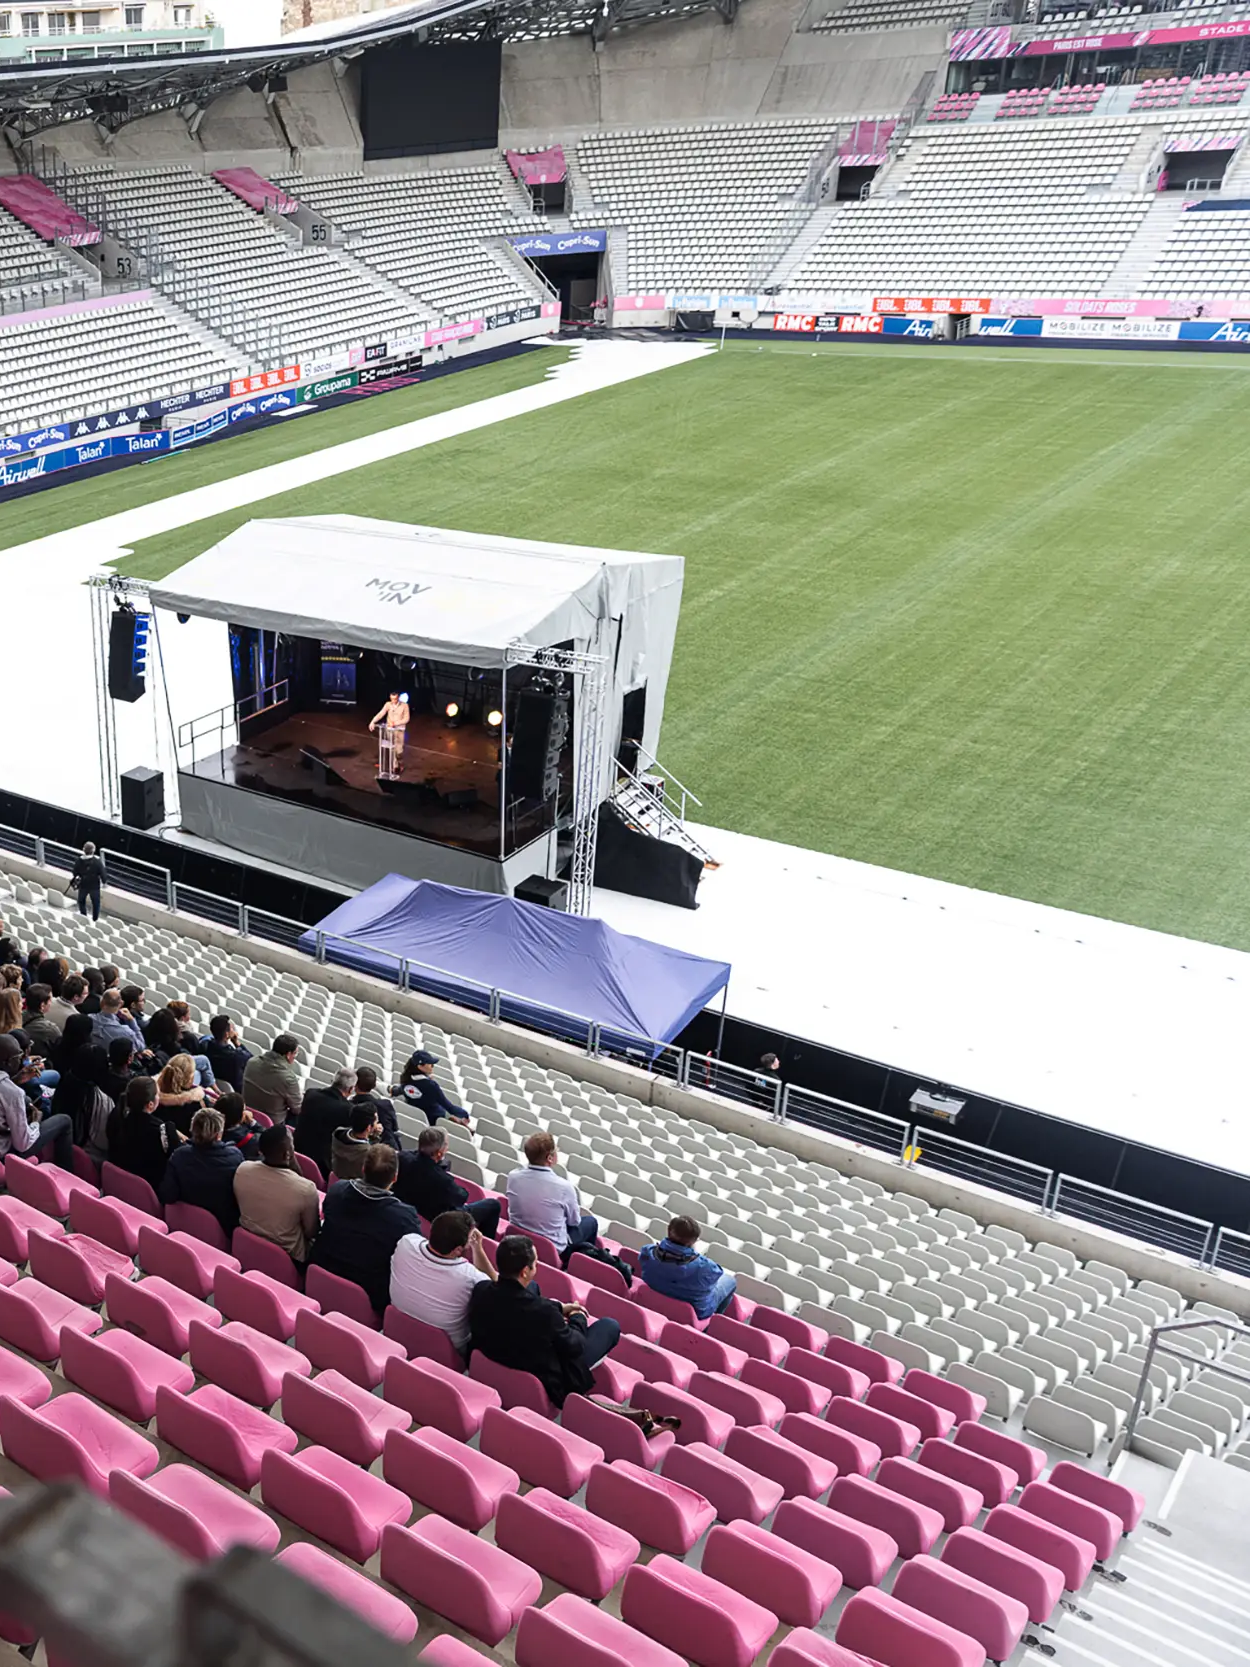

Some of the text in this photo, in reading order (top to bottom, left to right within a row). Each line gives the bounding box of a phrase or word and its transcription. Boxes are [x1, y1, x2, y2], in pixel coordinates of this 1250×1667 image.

[1199, 24, 1245, 37] STADE
[311, 224, 326, 241] 55
[558, 235, 600, 251] Capri-Sun
[117, 257, 132, 277] 53
[775, 314, 813, 331] RMC
[840, 315, 883, 332] RMC
[1050, 321, 1105, 332] MOBILIZE
[1112, 323, 1172, 333] MOBILIZE
[195, 385, 224, 400] HECHTER
[314, 376, 351, 395] Groupama
[160, 394, 190, 409] HECHTER
[28, 428, 65, 449] Capri-Sun
[125, 436, 159, 453] Talan
[75, 446, 102, 463] Talan
[365, 578, 432, 594] MOV
